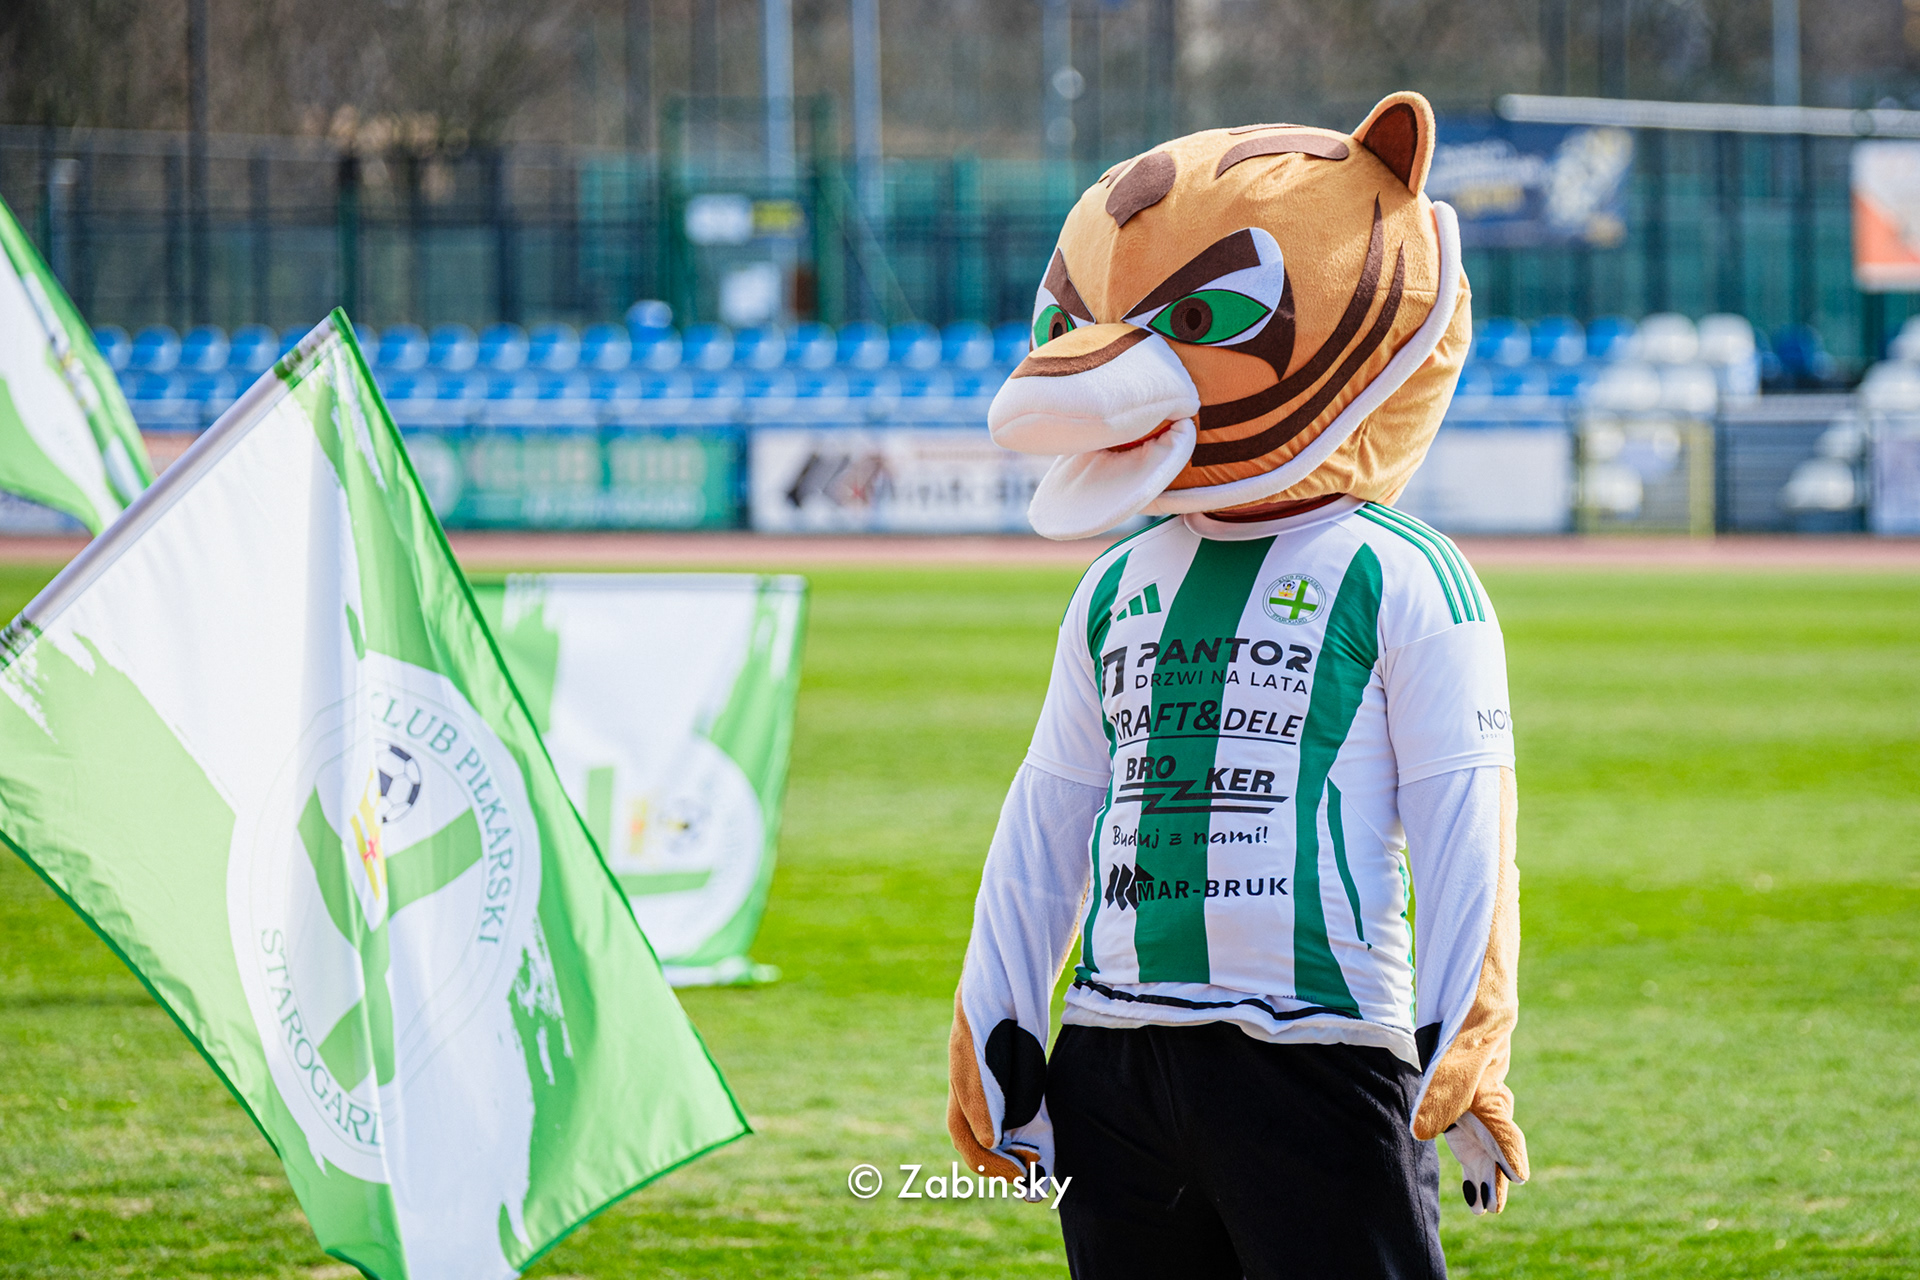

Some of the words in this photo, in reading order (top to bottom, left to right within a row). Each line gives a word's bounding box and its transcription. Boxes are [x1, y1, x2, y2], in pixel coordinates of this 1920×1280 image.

[1136, 637, 1313, 674] PANTOR
[1135, 671, 1203, 689] DRZWI
[1210, 669, 1241, 685] NA
[1250, 671, 1308, 695] LATA
[371, 692, 458, 755] LUB
[455, 746, 514, 944] PIŁKARSKI
[1112, 825, 1160, 849] Buduj
[1169, 832, 1182, 846] z
[1193, 826, 1269, 845] nami!
[1136, 877, 1289, 902] MAR-BRUK
